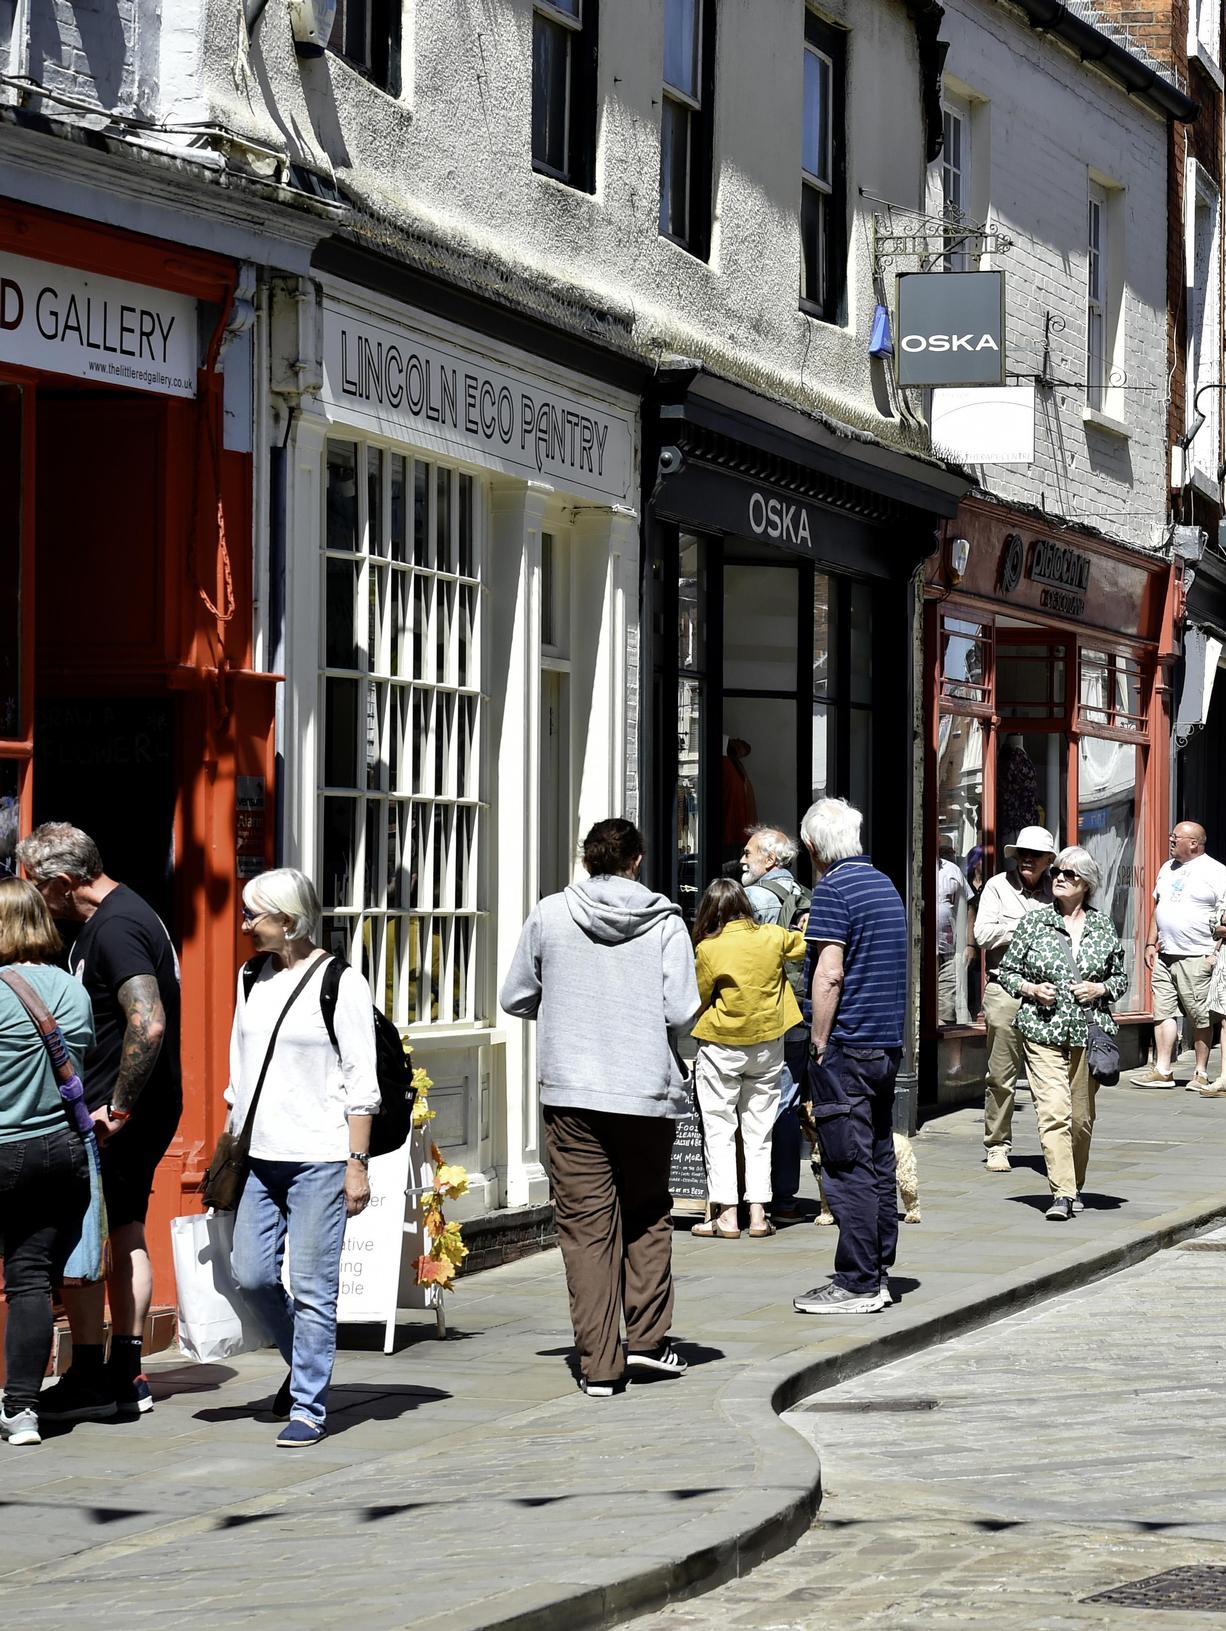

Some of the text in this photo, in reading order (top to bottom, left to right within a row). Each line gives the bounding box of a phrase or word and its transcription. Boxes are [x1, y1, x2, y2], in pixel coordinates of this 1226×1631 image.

[36, 286, 176, 364] GALLERY
[901, 333, 1000, 353] OSKA
[88, 360, 193, 391] www.thelittleredgallery.co.uk
[341, 330, 609, 477] LINCOLN ECO PANTRY
[749, 492, 812, 548] OSKA
